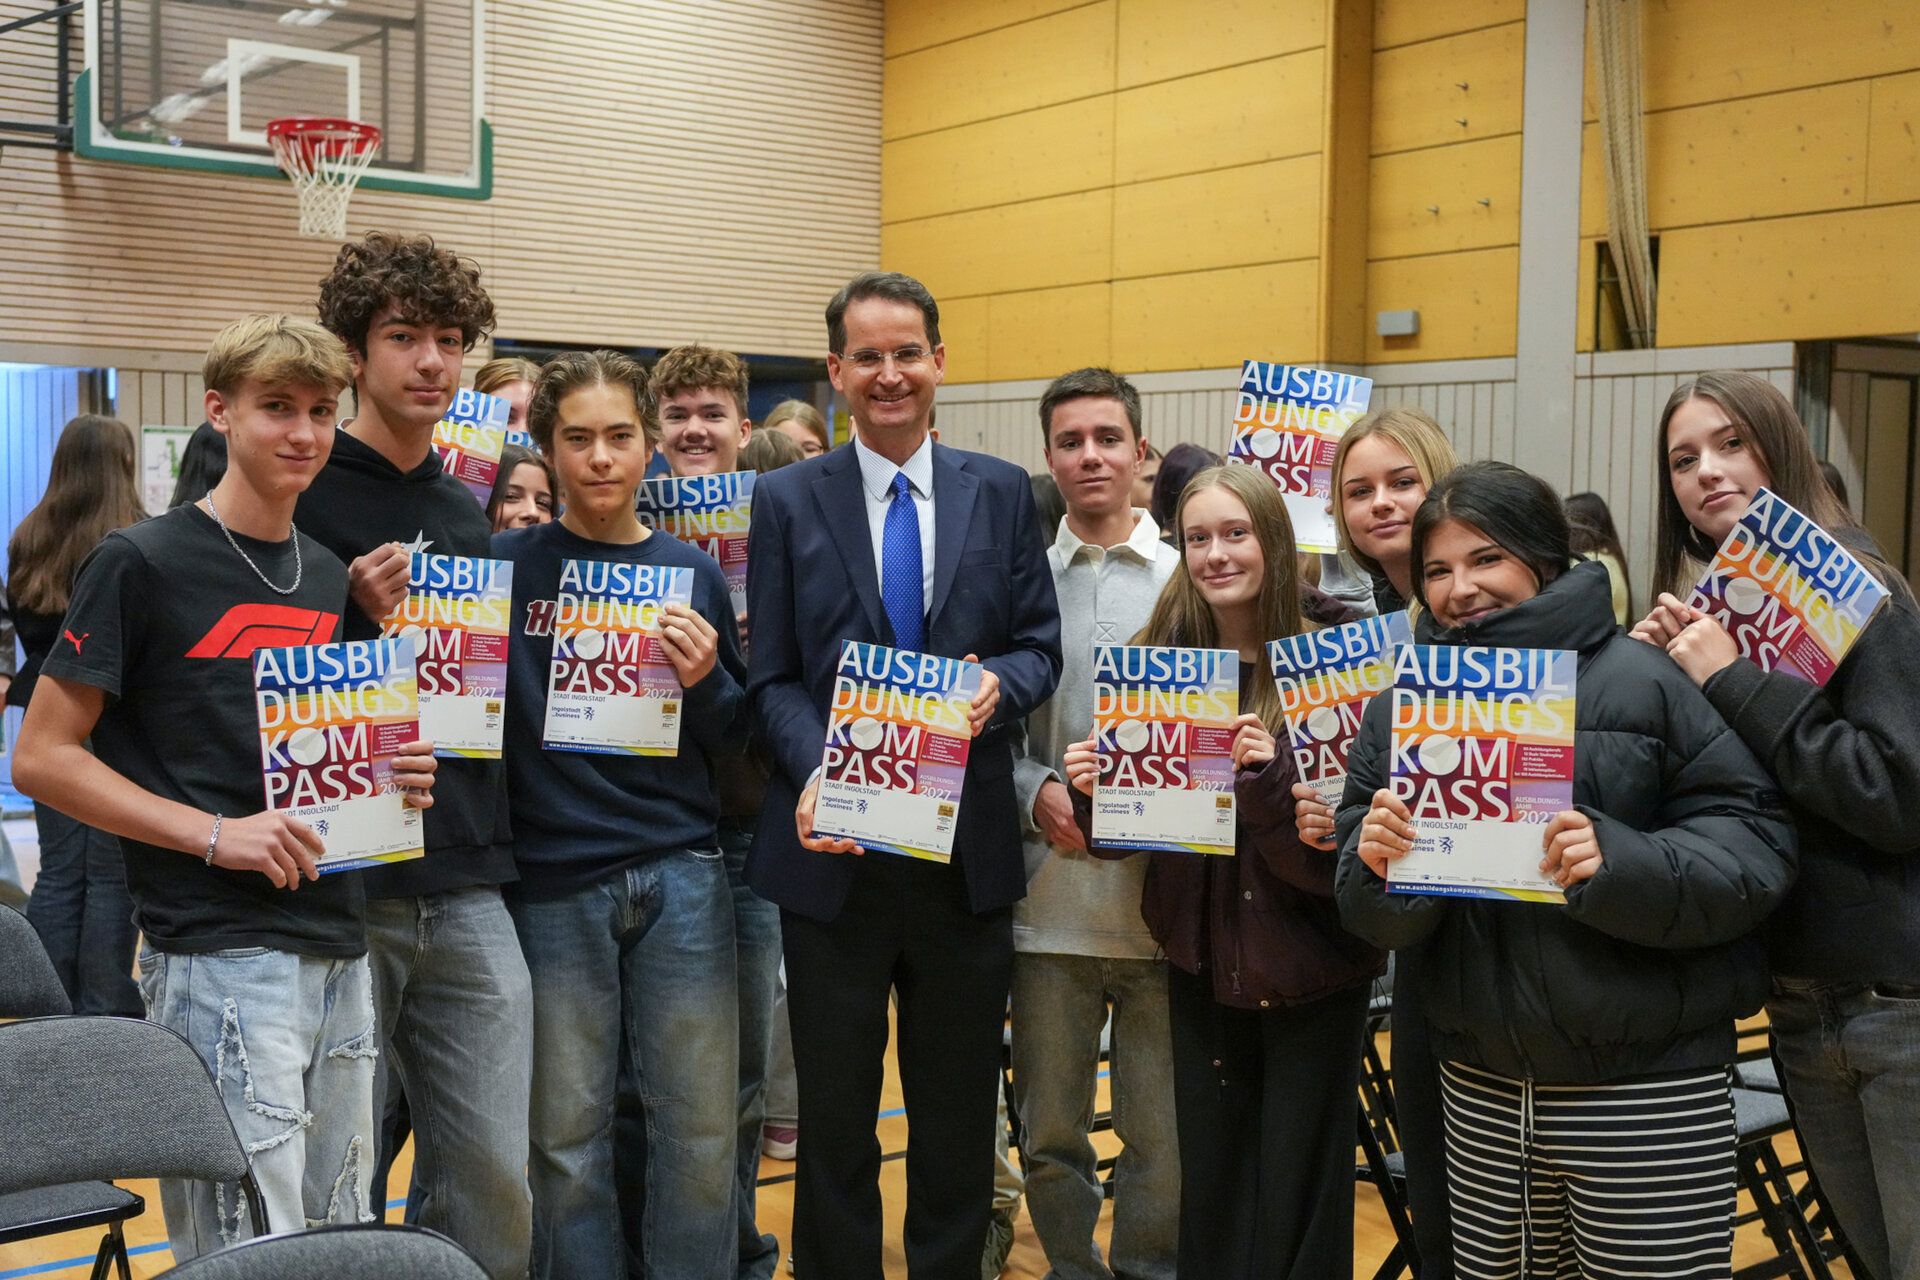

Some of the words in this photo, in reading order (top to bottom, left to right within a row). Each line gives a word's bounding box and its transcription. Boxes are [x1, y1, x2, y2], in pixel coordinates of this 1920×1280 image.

[1240, 360, 1363, 407] AUSBIL
[448, 387, 503, 426] BIL
[1235, 391, 1358, 434] DUNGS
[431, 415, 497, 455] NGS
[635, 471, 753, 509] AUSBIL
[1227, 455, 1310, 496] SS
[1314, 488, 1330, 499] 20
[408, 552, 506, 593] USBIL
[1741, 493, 1870, 620] AUSBIL
[559, 559, 686, 599] AUSBIL
[1718, 522, 1854, 648] DUNGS
[385, 588, 503, 627] UNGS
[255, 639, 411, 688] AUSBIL
[1094, 646, 1232, 684] AUSBIL
[1270, 615, 1406, 676] AUSBIL
[418, 660, 461, 696] SS
[549, 660, 639, 697] PASS
[837, 640, 973, 696] AUSBIL
[1393, 644, 1568, 692] AUSBIL
[257, 677, 411, 728] DUNGS
[467, 686, 497, 698] 2027
[571, 694, 606, 703] INGOLSTADT
[643, 687, 673, 699] 2027
[832, 676, 967, 730] DUNGS
[1094, 681, 1230, 719] DUNGS
[1392, 688, 1565, 737] DUNGS
[821, 746, 916, 795] PASS
[1097, 754, 1189, 791] PASS
[1293, 738, 1354, 784] PA
[264, 761, 374, 810] PASS
[821, 795, 854, 806] Ingolstadt
[824, 781, 843, 789] STADT
[844, 785, 881, 797] INGOLSTADT
[921, 785, 952, 801] 2027
[1118, 789, 1156, 797] INGOLSTADT
[1194, 780, 1227, 792] 2027
[1390, 776, 1511, 822] PASS
[1514, 797, 1564, 805] AUSBILDUNGS-
[298, 805, 340, 817] INGOLSTADT
[1421, 820, 1468, 830] INGOLSTADT
[1395, 884, 1486, 895] www.ausbildungskompass.de
